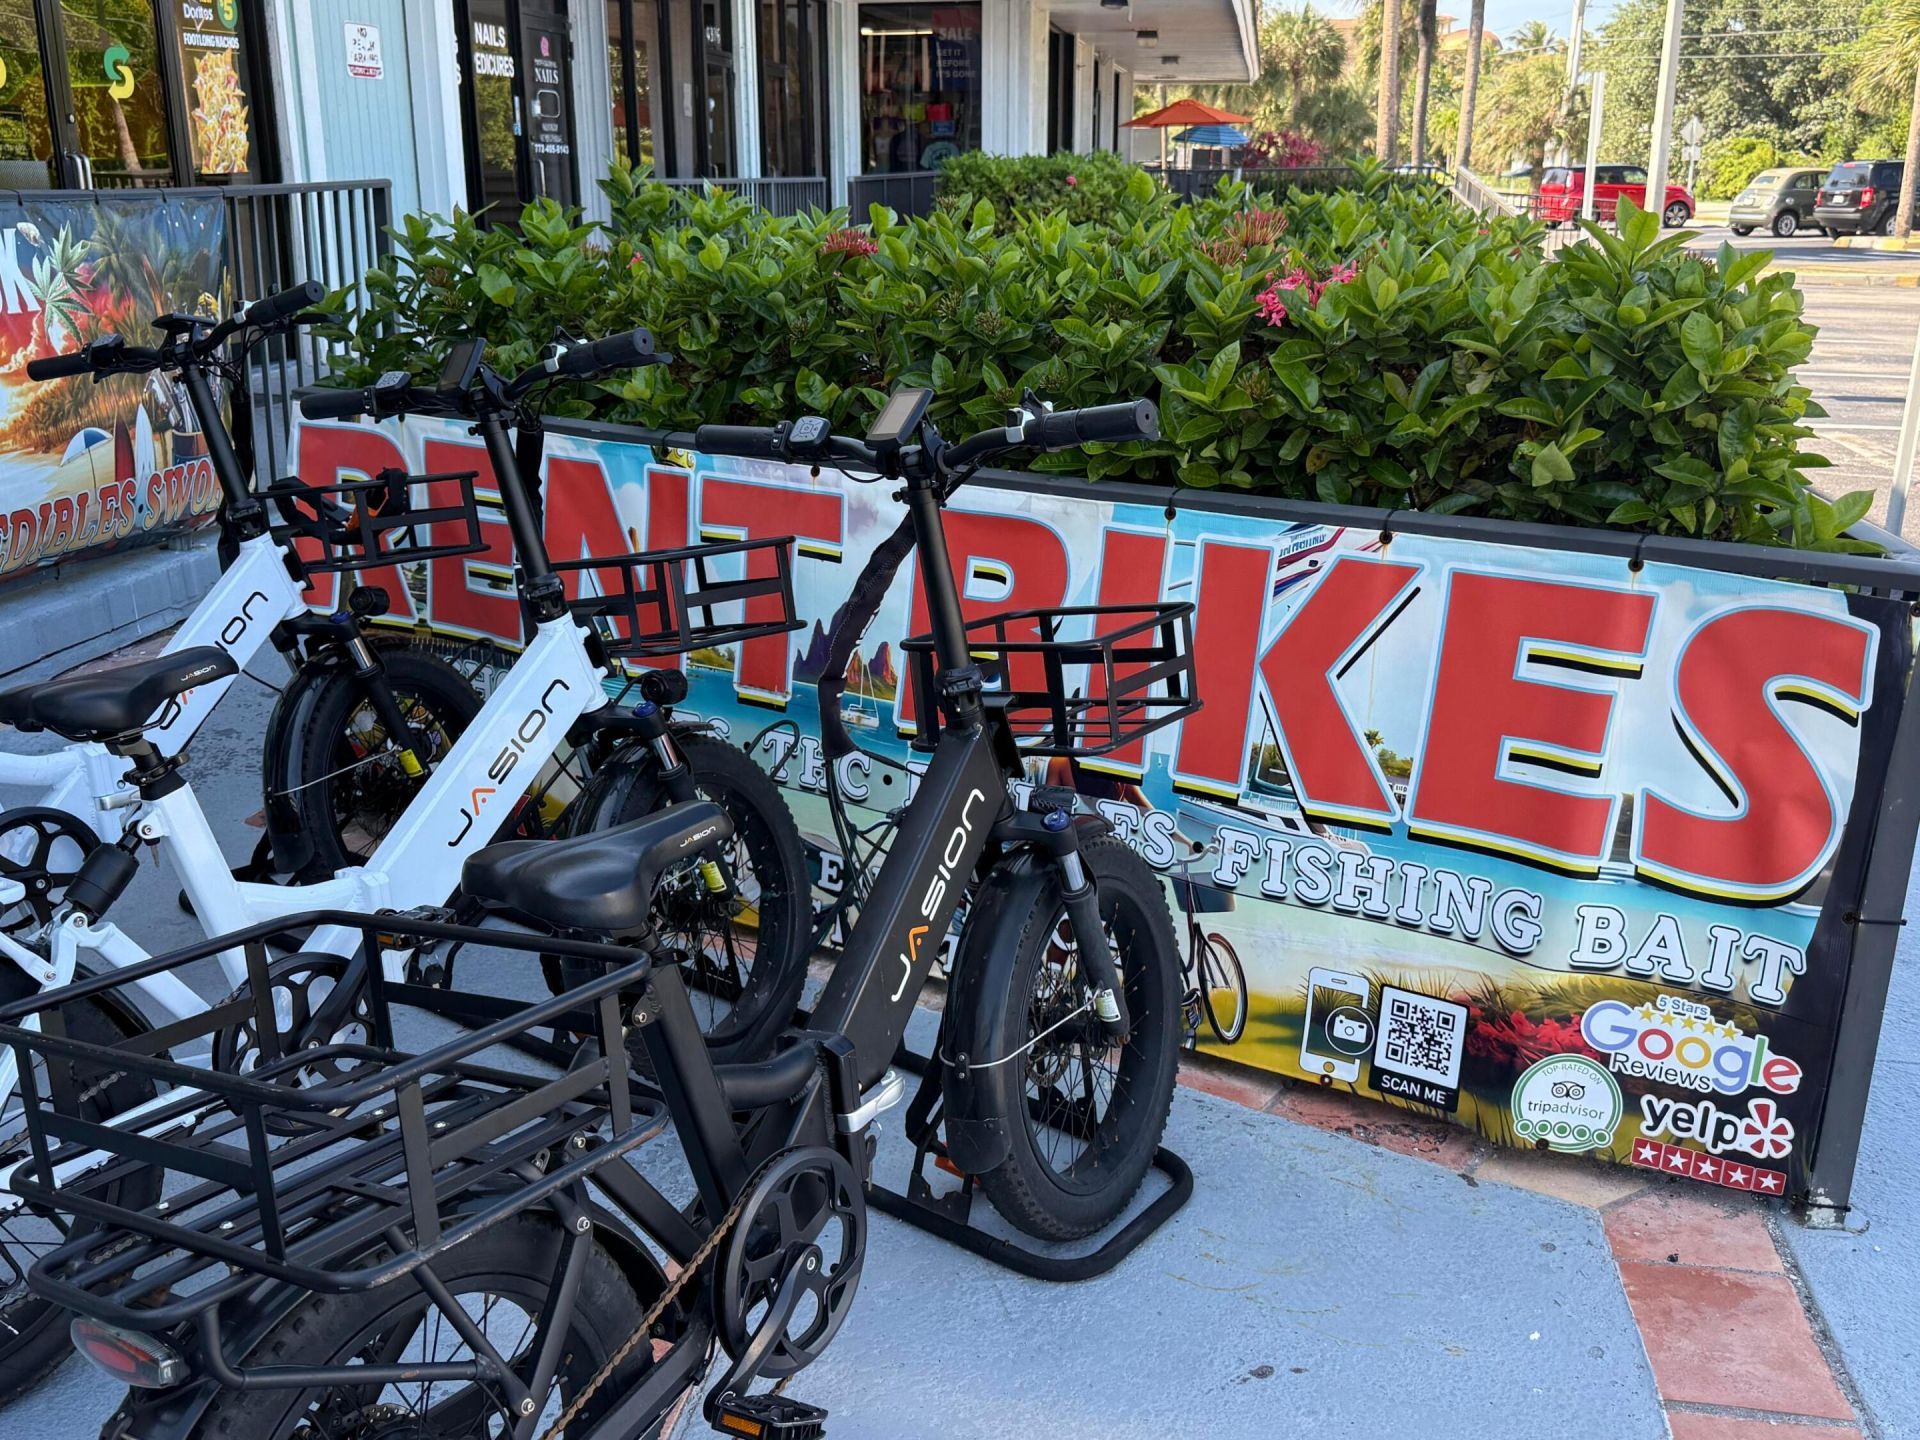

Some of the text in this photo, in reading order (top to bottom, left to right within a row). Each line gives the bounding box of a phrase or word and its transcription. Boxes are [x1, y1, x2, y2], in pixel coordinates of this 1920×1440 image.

[183, 3, 213, 20] Doritos
[183, 32, 240, 49] FOOTLONG NACHOS
[474, 21, 506, 47] NAILS
[939, 27, 972, 40] SALE
[535, 67, 559, 84] NAILS
[293, 418, 849, 703] RENT
[895, 507, 1882, 906] BIKES
[447, 678, 571, 847] JASION
[679, 825, 717, 847] JASION
[890, 787, 986, 1003] JASION
[1211, 824, 1545, 955] FISHING
[1567, 901, 1808, 1006] BAIT
[1657, 995, 1709, 1017] 5 Stars
[1583, 1001, 1800, 1094] Google
[1610, 1051, 1712, 1092] Reviews
[1380, 1074, 1446, 1105] SCAN ME
[1527, 1100, 1605, 1120] tripadvisor
[1642, 1098, 1739, 1151] yelp
